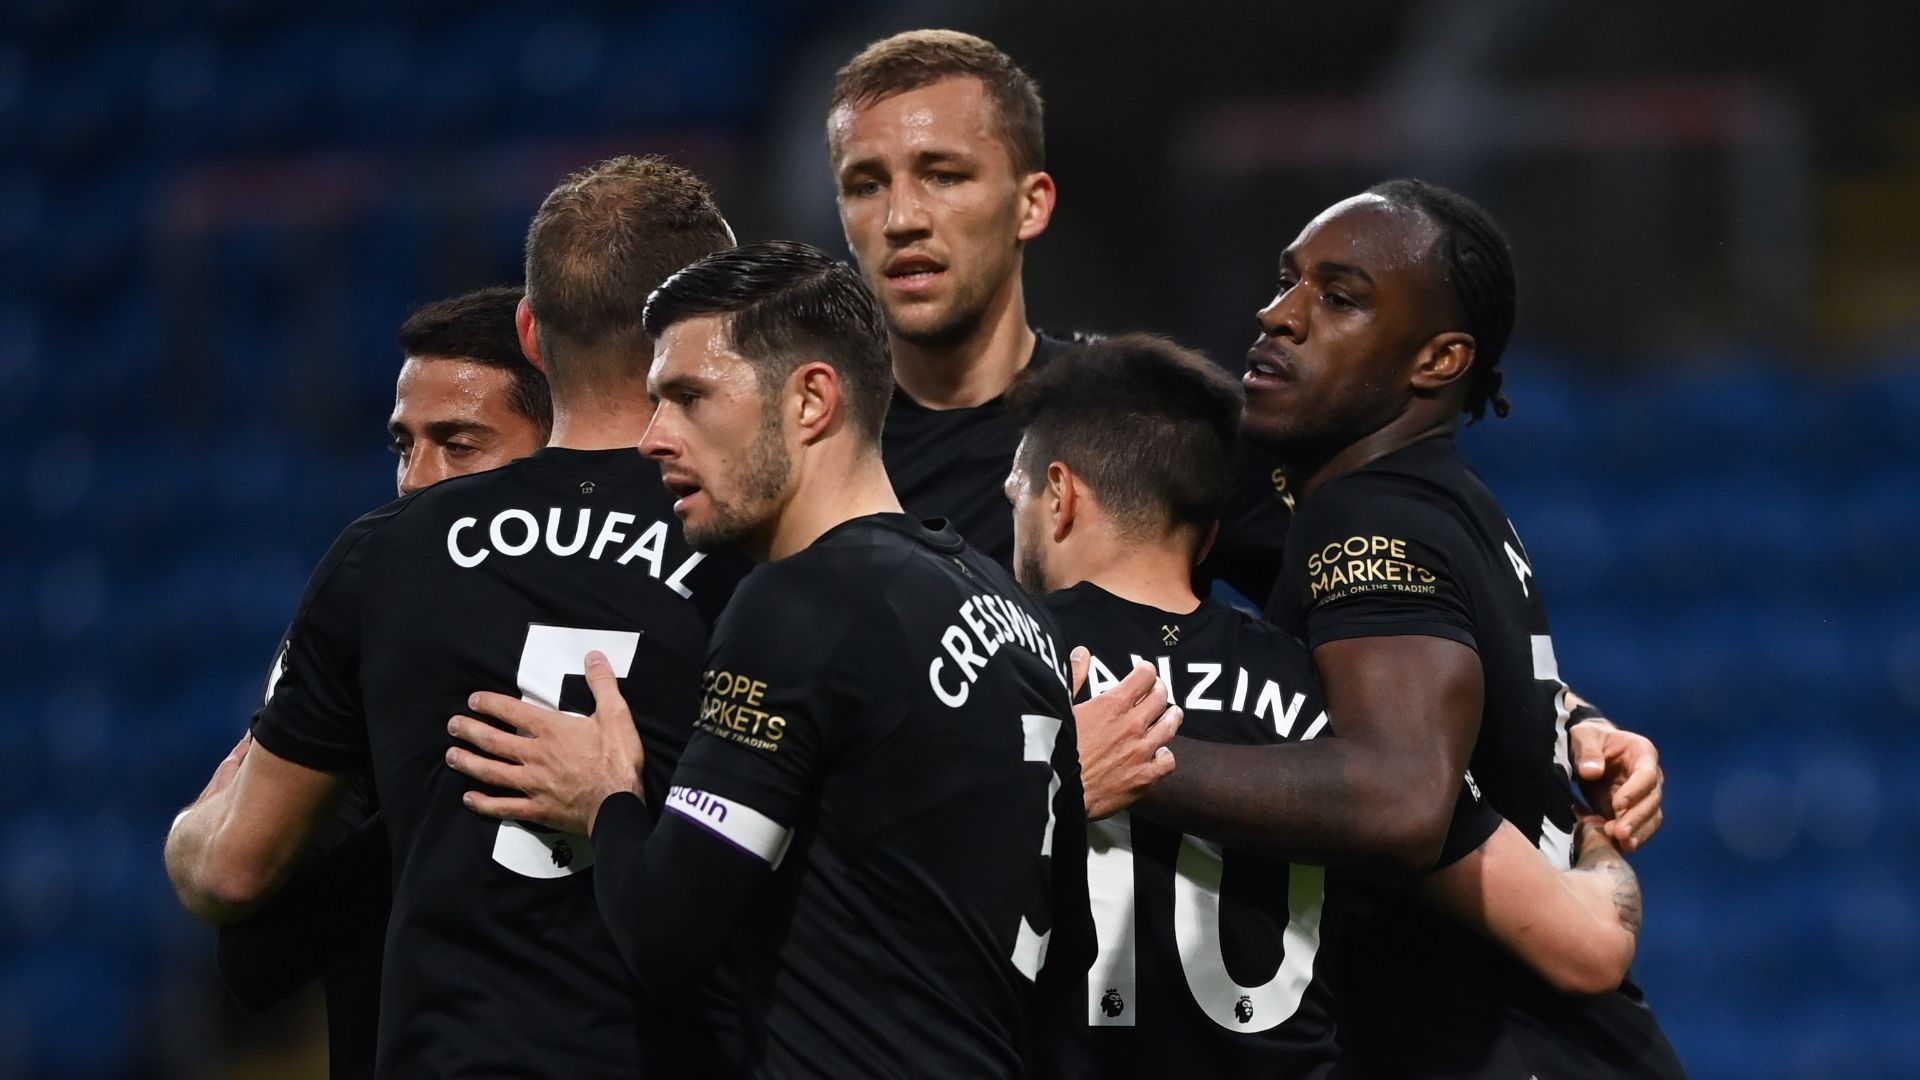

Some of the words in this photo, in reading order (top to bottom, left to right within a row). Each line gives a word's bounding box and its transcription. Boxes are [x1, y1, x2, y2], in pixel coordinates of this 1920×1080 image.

[447, 507, 708, 599] COUFAL
[1308, 535, 1407, 577] SCOPE
[1350, 584, 1389, 594] ONLINE
[1392, 584, 1436, 594] TRADING
[700, 695, 787, 741] ARKETS
[703, 670, 768, 707] COPE
[1088, 653, 1329, 742] ANZINI
[491, 624, 644, 879] 5
[1087, 810, 1326, 1034] 10
